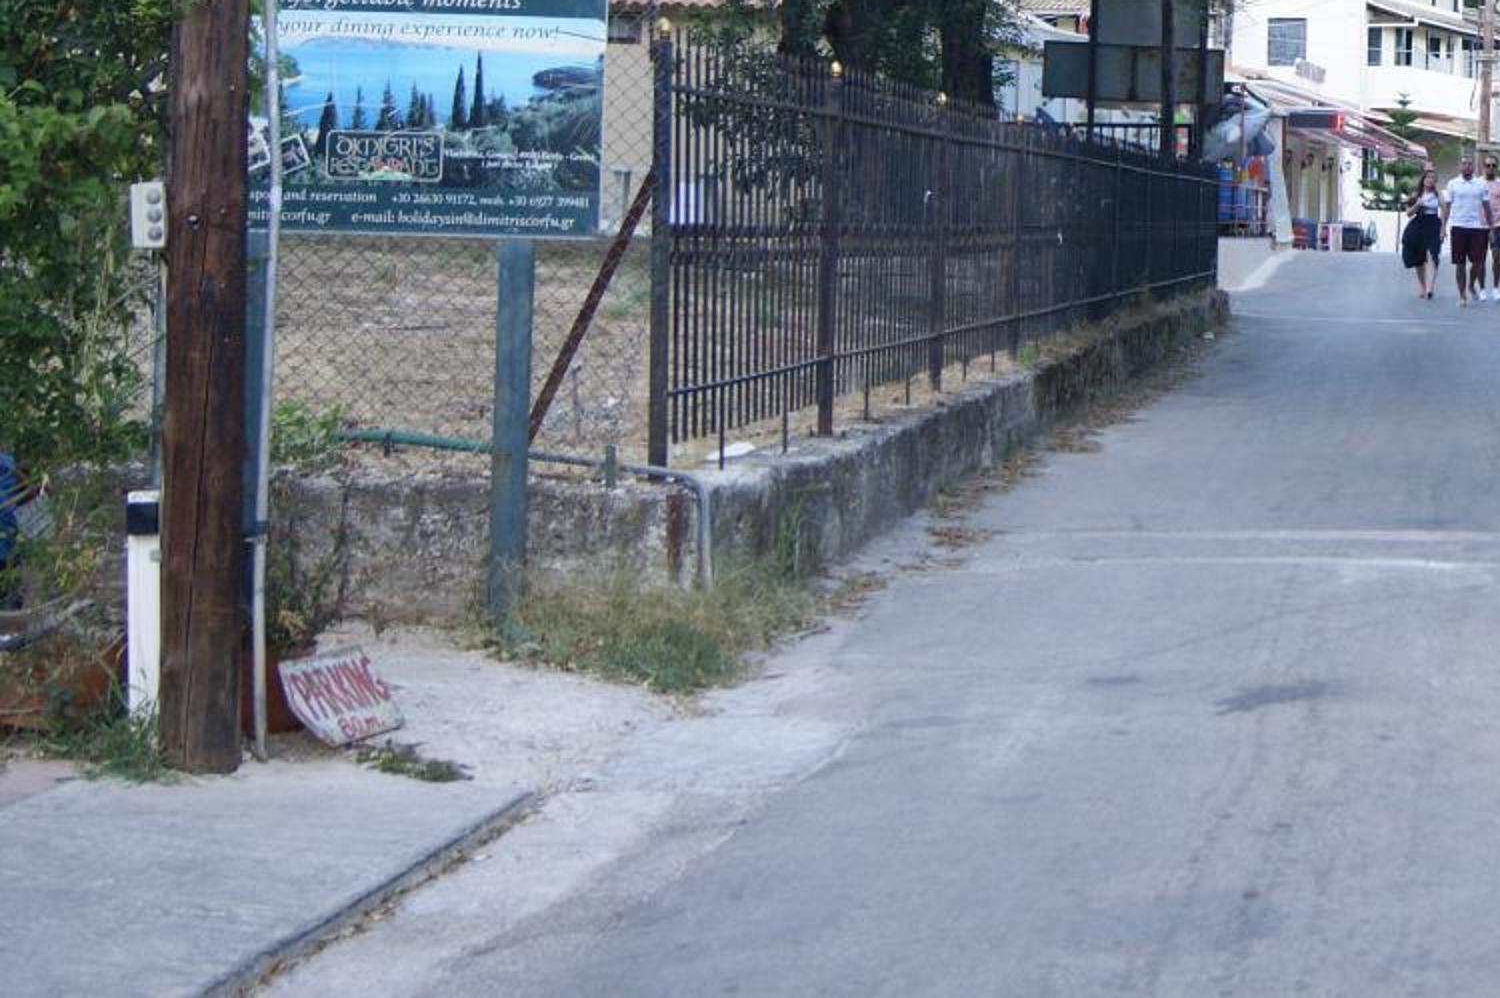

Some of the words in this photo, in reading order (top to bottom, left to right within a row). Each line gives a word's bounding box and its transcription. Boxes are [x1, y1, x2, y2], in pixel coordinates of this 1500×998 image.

[399, 20, 506, 39] experience
[283, 188, 307, 201] and
[310, 189, 377, 203] reservation
[351, 211, 395, 224] e-mail:
[286, 656, 391, 721] PARKING
